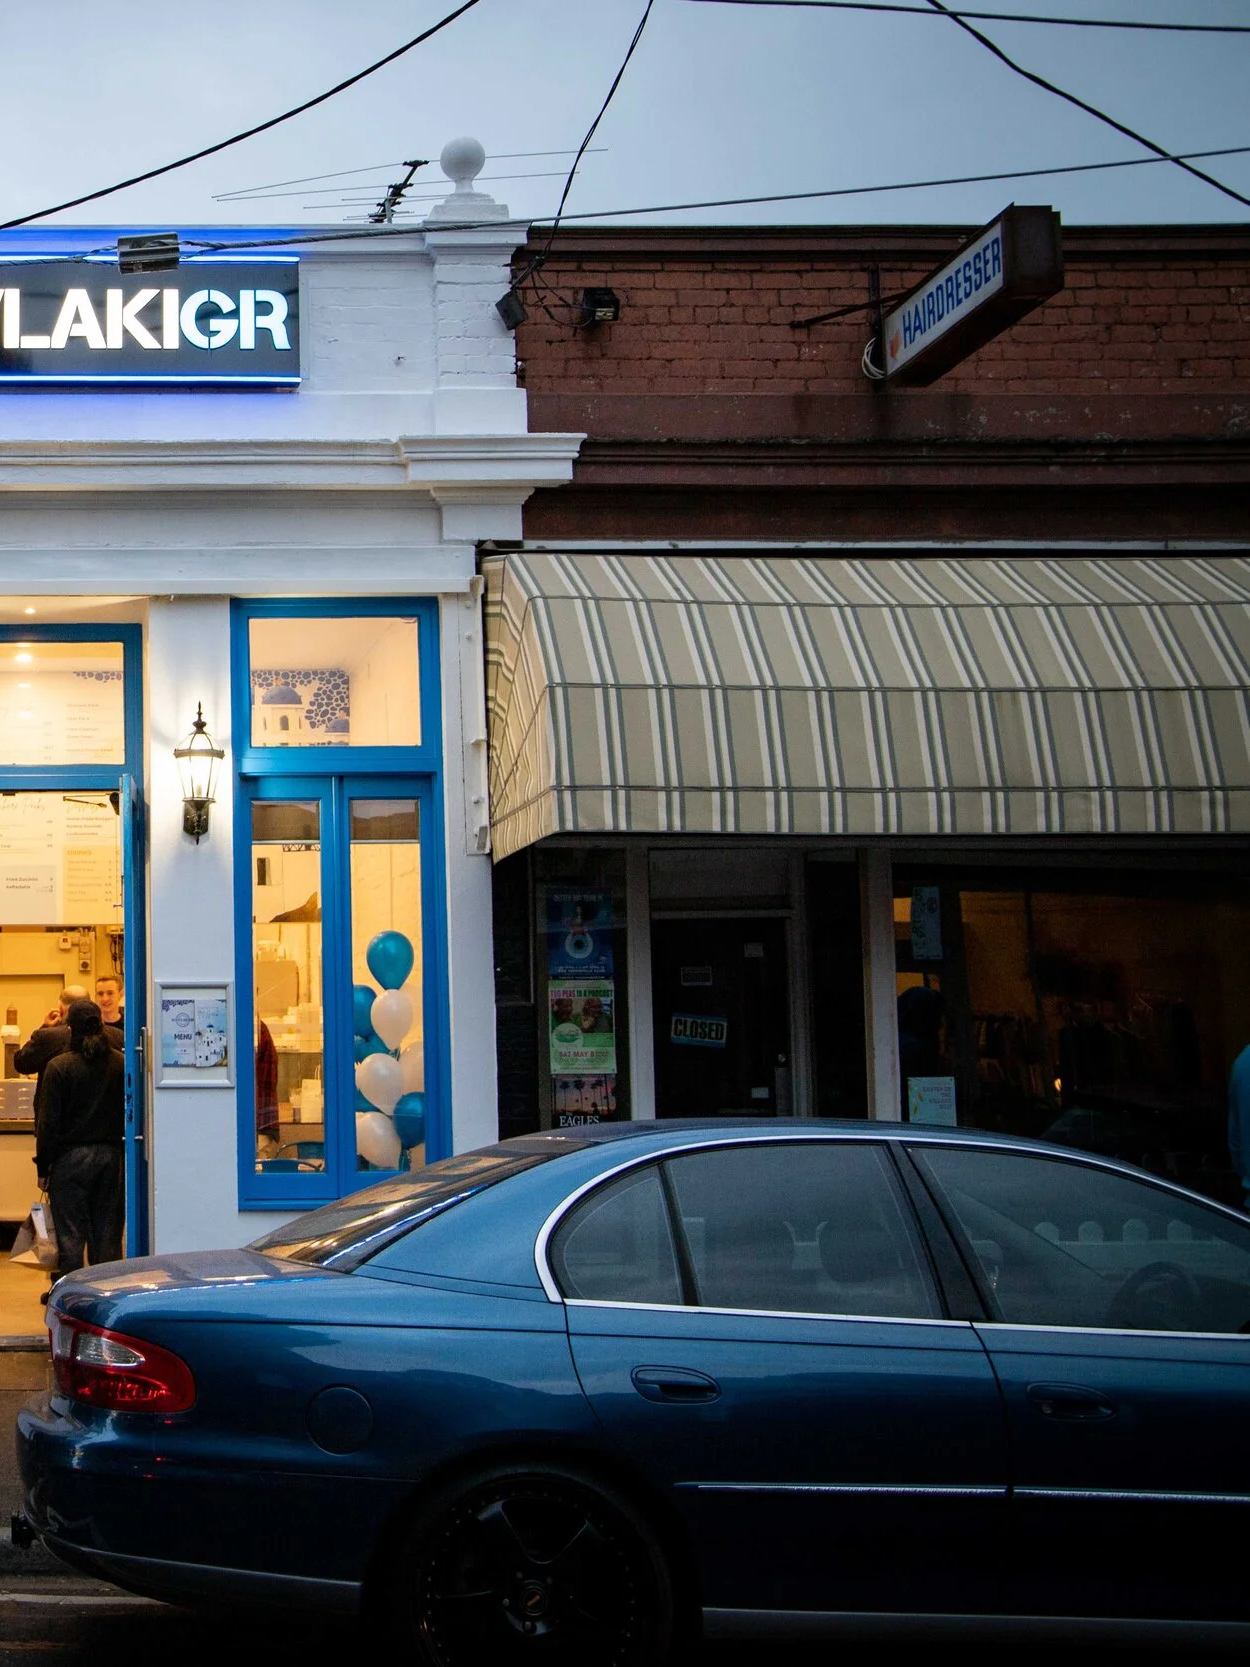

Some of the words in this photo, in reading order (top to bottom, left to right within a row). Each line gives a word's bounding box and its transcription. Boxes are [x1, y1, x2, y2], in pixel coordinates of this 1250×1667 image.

[901, 236, 1001, 349] HAIRDRESSER
[674, 1018, 724, 1041] CLOSED
[573, 1050, 588, 1058] MAY
[559, 1115, 600, 1127] EAGLES
